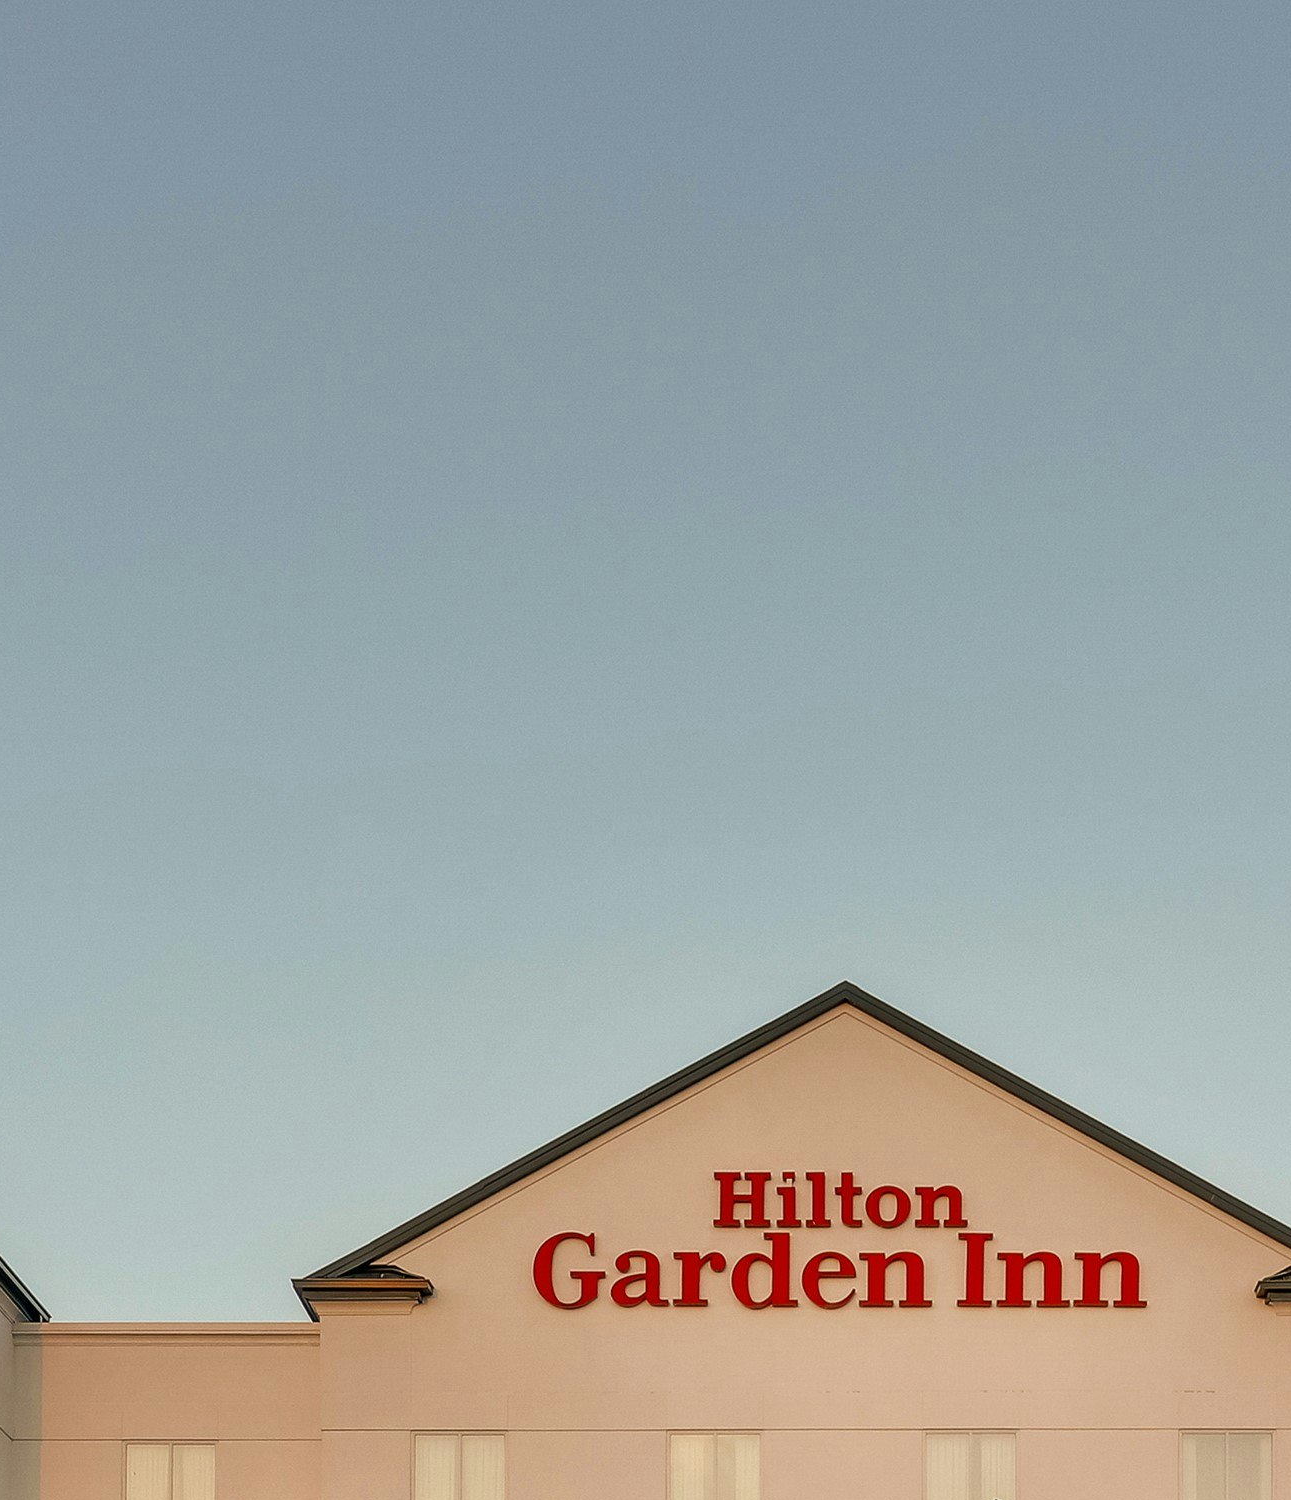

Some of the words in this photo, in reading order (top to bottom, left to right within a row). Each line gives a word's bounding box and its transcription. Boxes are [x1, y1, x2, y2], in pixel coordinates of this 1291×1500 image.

[713, 1171, 967, 1228] Hilton
[532, 1231, 933, 1309] Garden
[957, 1231, 1147, 1307] Inn
